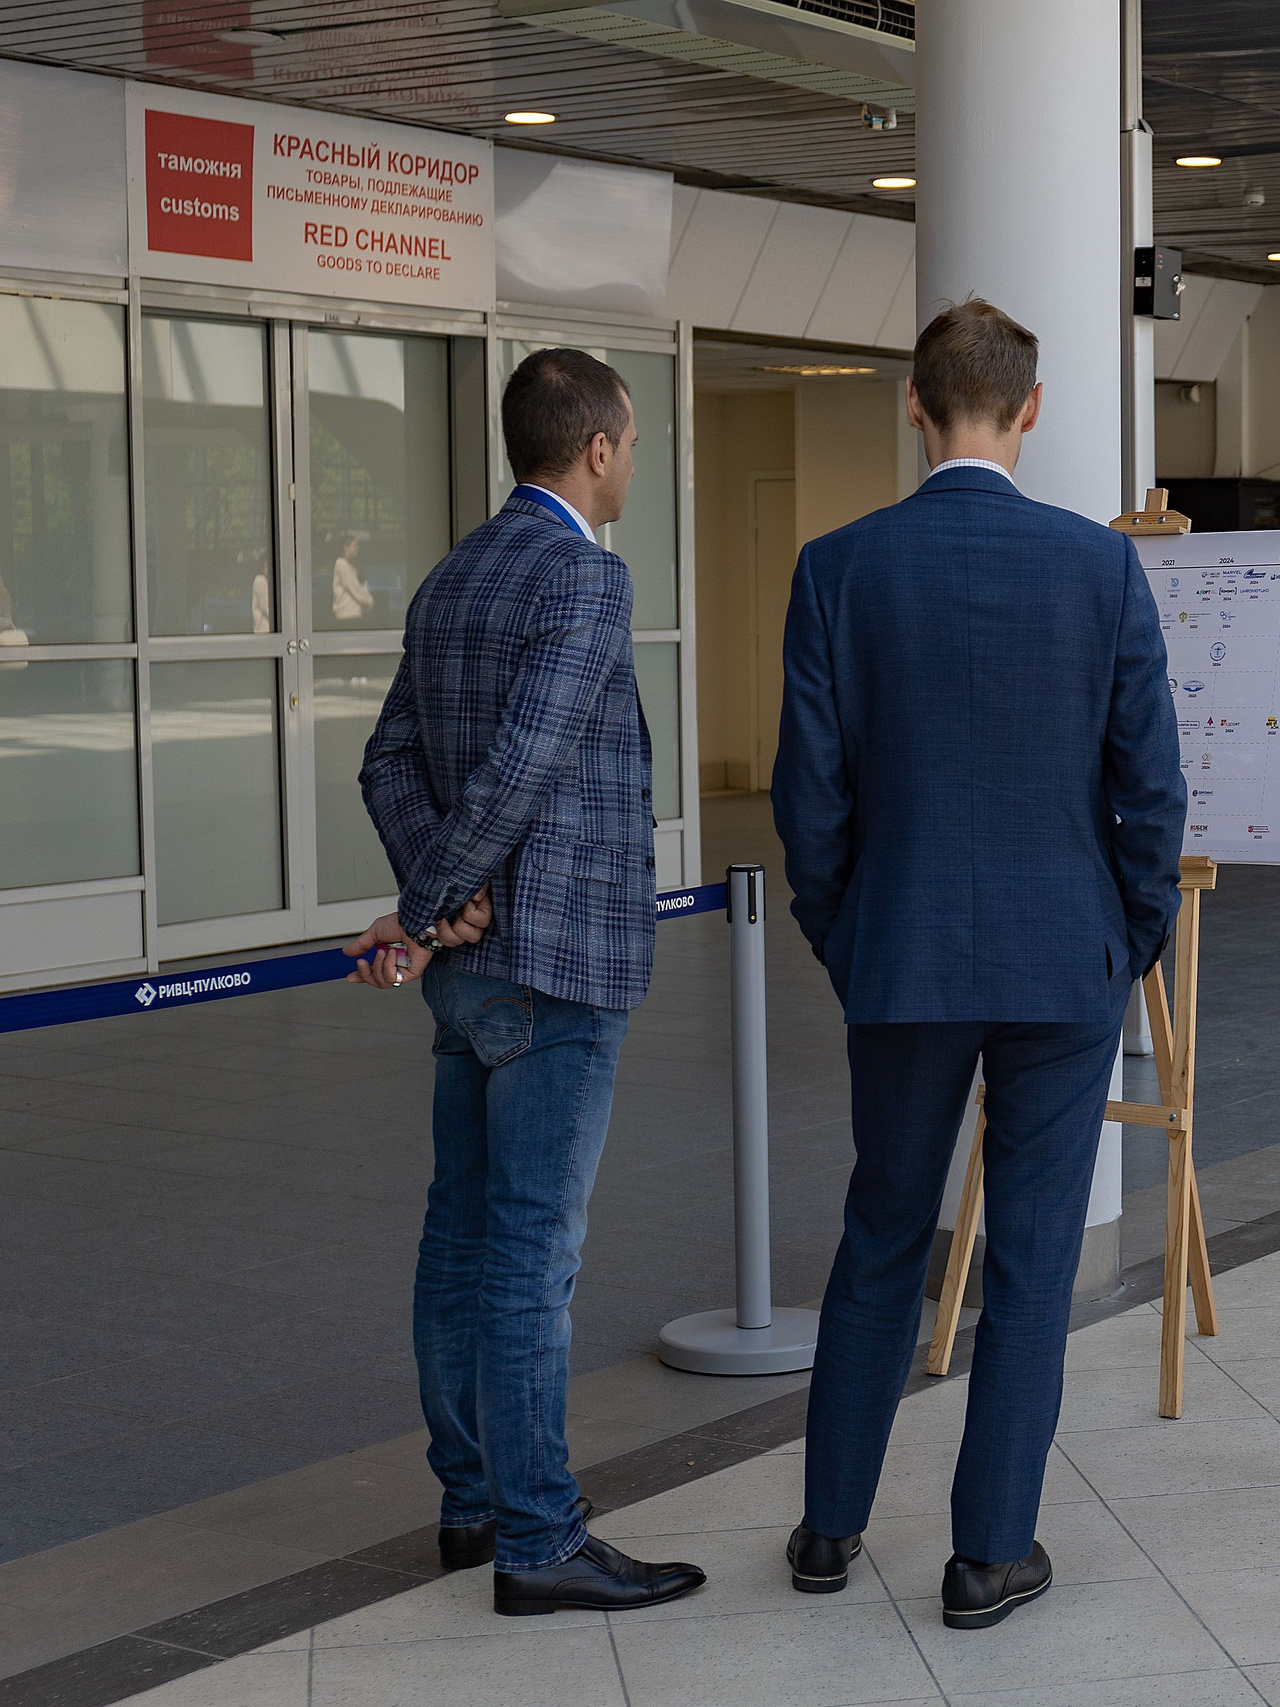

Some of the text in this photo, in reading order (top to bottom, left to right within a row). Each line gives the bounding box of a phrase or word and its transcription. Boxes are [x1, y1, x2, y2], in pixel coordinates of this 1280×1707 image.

[157, 151, 242, 179] таможня
[272, 132, 479, 186] КРАСНЫЙ КОРИДОР
[306, 169, 453, 203] ТОВАРЫ, ПОДЛЕЖАЩИЕ
[160, 195, 240, 222] customs
[267, 185, 484, 227] ПИСЬМЕННОМУ ДЕКЛАРИРОВАНИЮ
[304, 222, 451, 261] RED CHANNEL
[317, 254, 440, 280] GOODS TO DECLARE
[158, 972, 250, 998] РИВЦ-ПУЛКОВО
